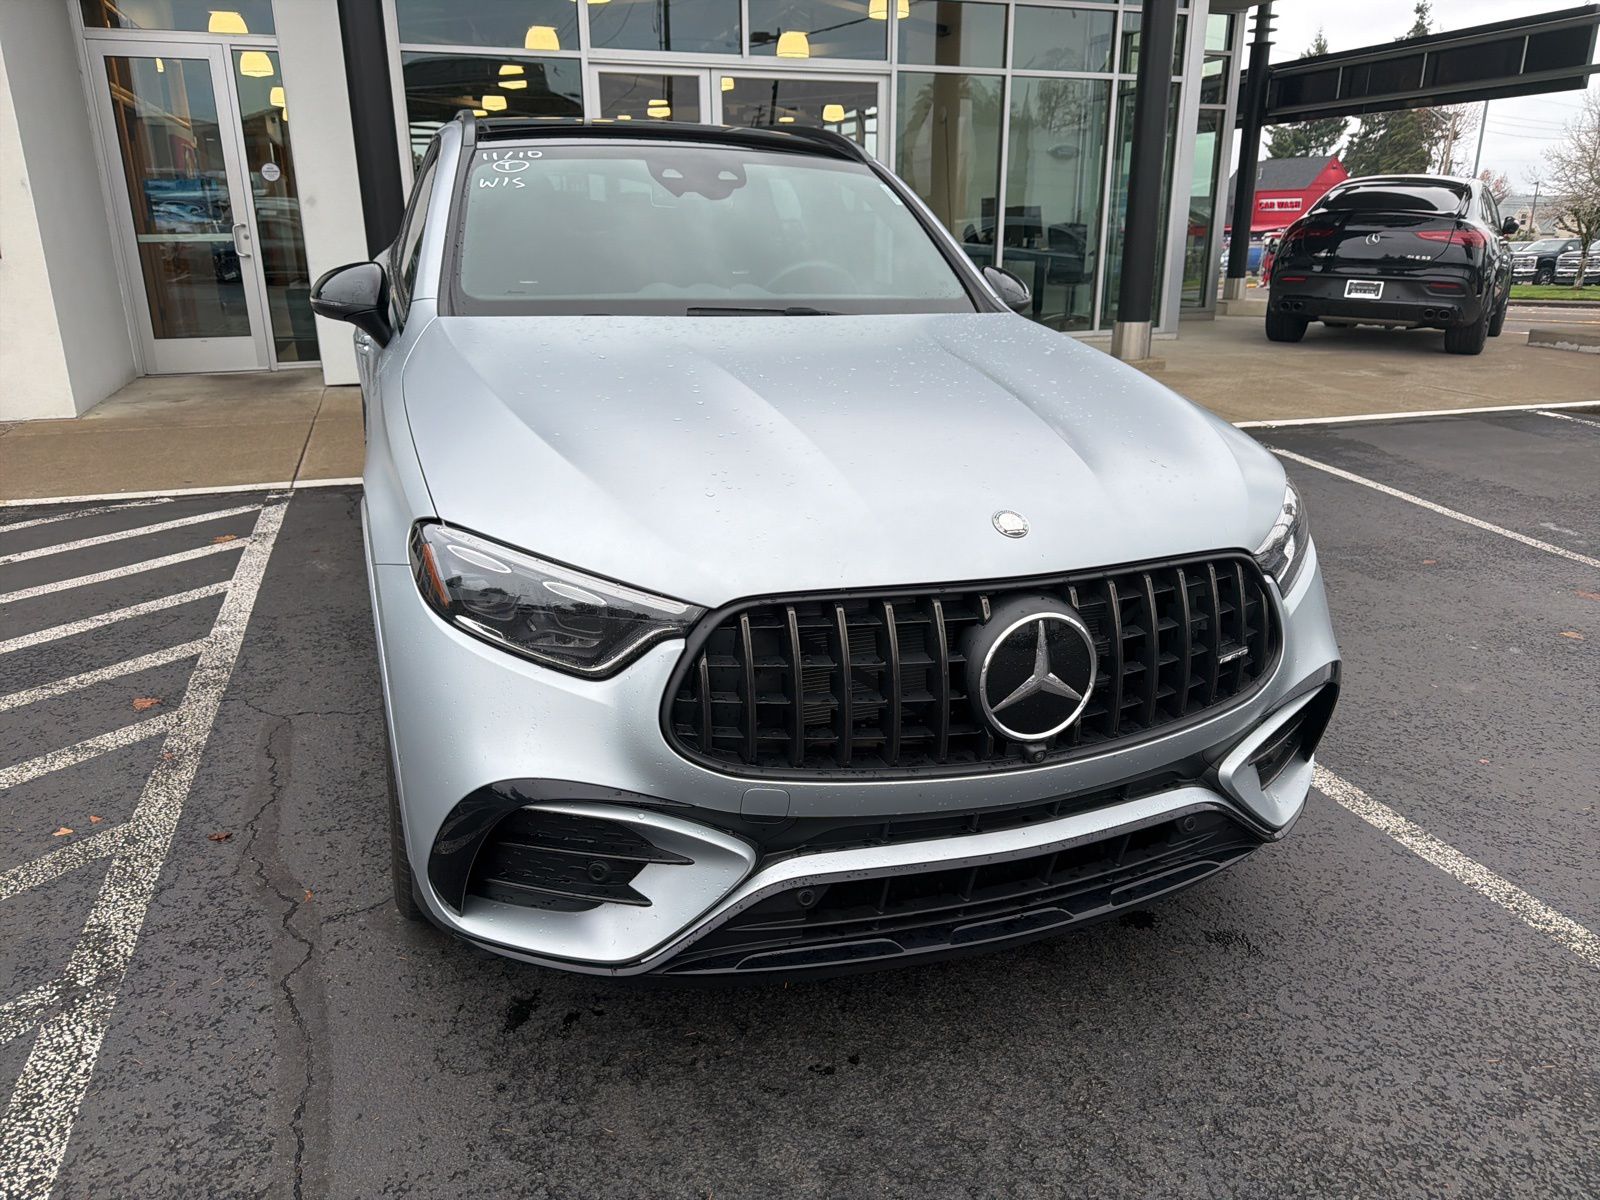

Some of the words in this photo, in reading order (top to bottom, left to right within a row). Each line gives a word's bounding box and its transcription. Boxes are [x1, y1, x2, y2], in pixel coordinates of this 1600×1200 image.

[482, 150, 543, 160] 11/10
[1259, 201, 1275, 209] CAR
[1276, 201, 1301, 209] WASH
